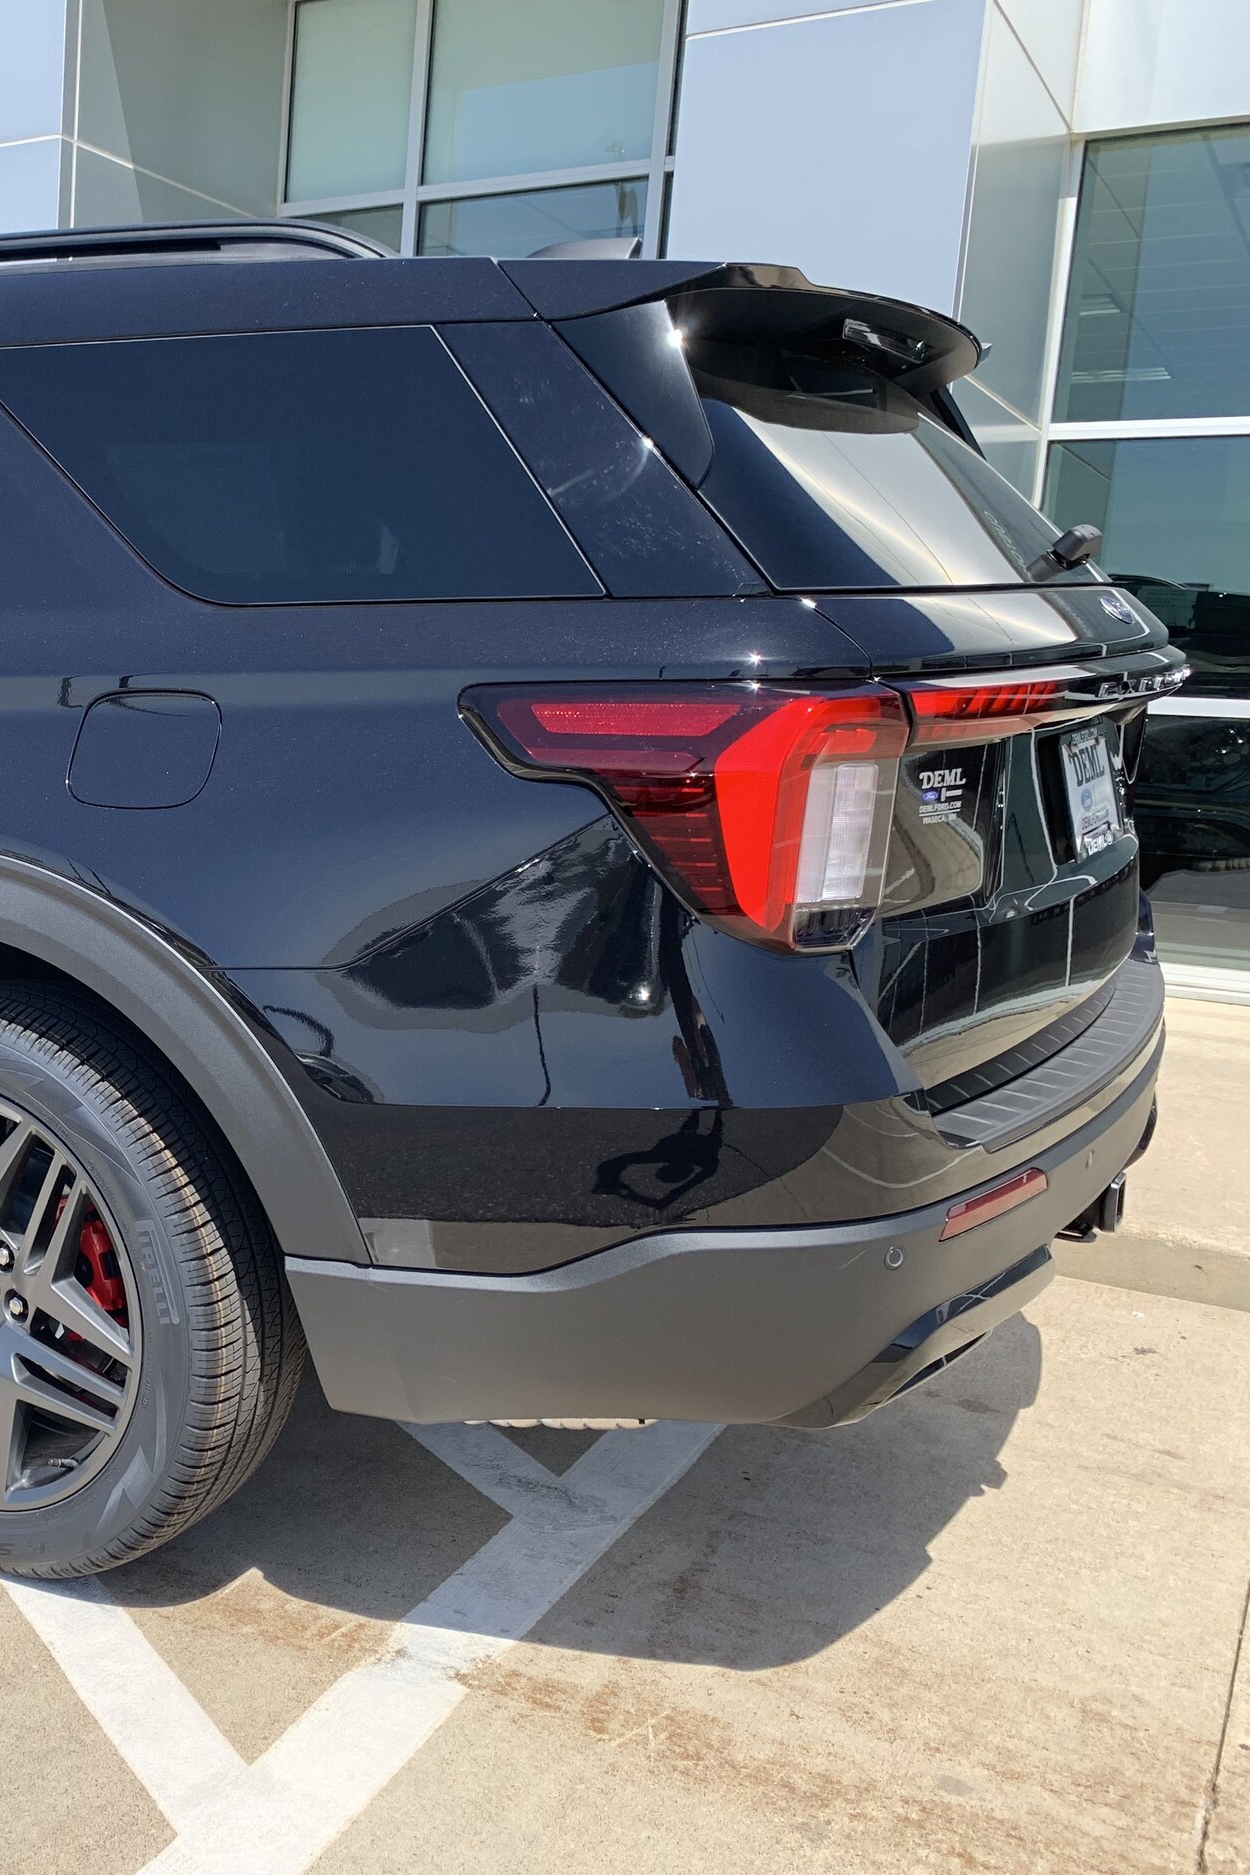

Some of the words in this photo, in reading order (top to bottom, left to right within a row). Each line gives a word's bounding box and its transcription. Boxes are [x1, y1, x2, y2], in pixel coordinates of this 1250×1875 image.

[919, 768, 967, 789] DEML
[1069, 743, 1105, 787] DEML
[919, 801, 962, 813] DEMLFORD.COM
[135, 1217, 180, 1326] PIRELLI
